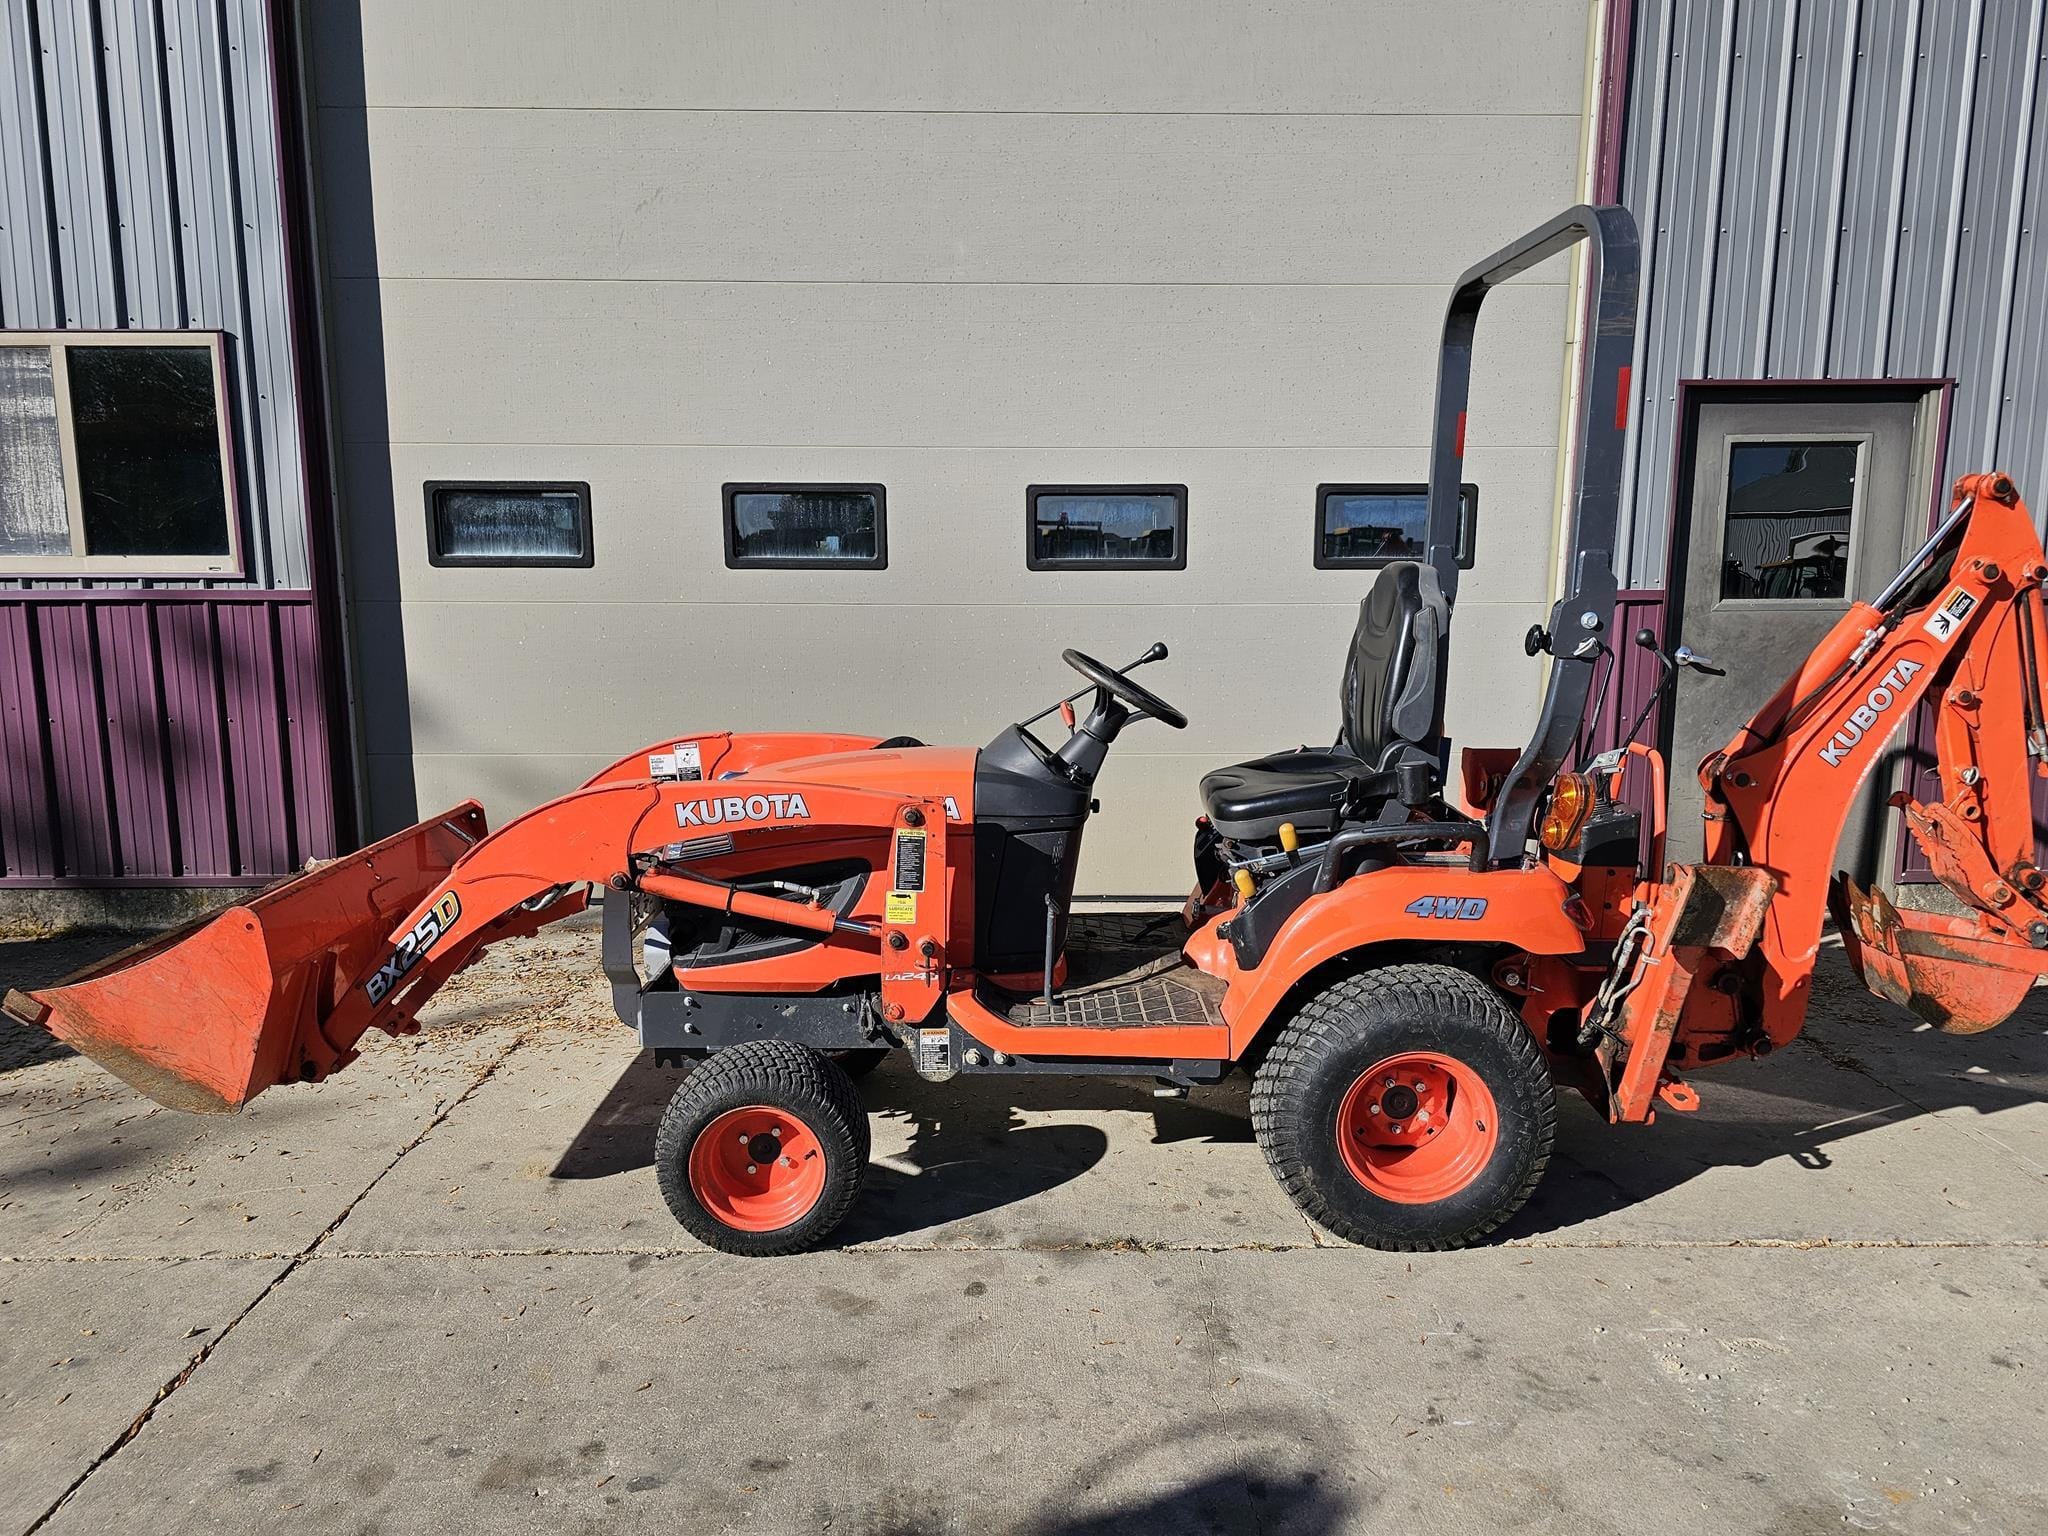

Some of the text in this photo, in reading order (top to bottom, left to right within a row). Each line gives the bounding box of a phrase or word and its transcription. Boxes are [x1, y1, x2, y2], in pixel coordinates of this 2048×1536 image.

[1818, 658, 1925, 768] KUBOTA
[674, 793, 810, 828] KUBOTA
[1405, 895, 1488, 920] 4WD
[364, 890, 462, 1007] BX25D
